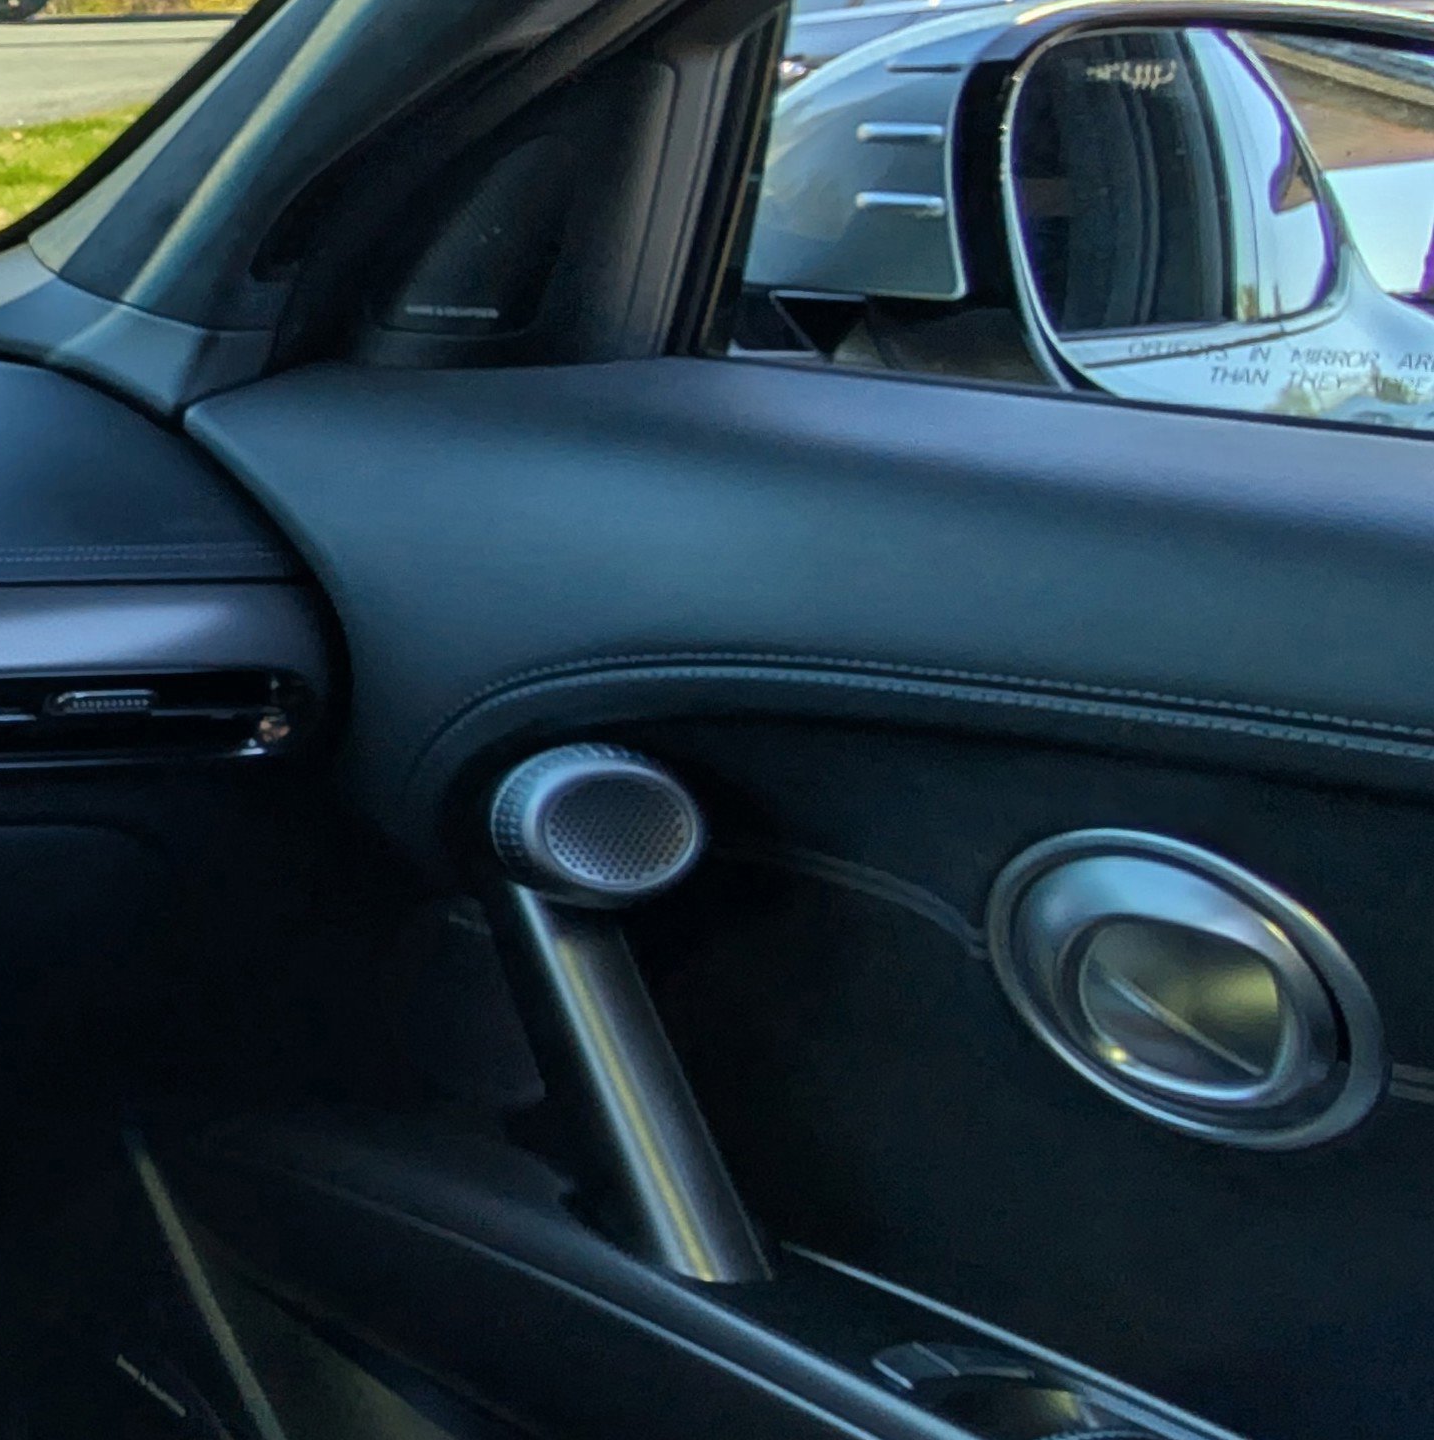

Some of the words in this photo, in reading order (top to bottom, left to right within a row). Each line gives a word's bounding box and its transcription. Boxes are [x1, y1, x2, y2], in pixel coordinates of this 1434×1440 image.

[1248, 346, 1272, 362] IN
[1290, 347, 1380, 368] MIRROR
[1397, 352, 1434, 373] AR
[1210, 365, 1270, 386] THAN
